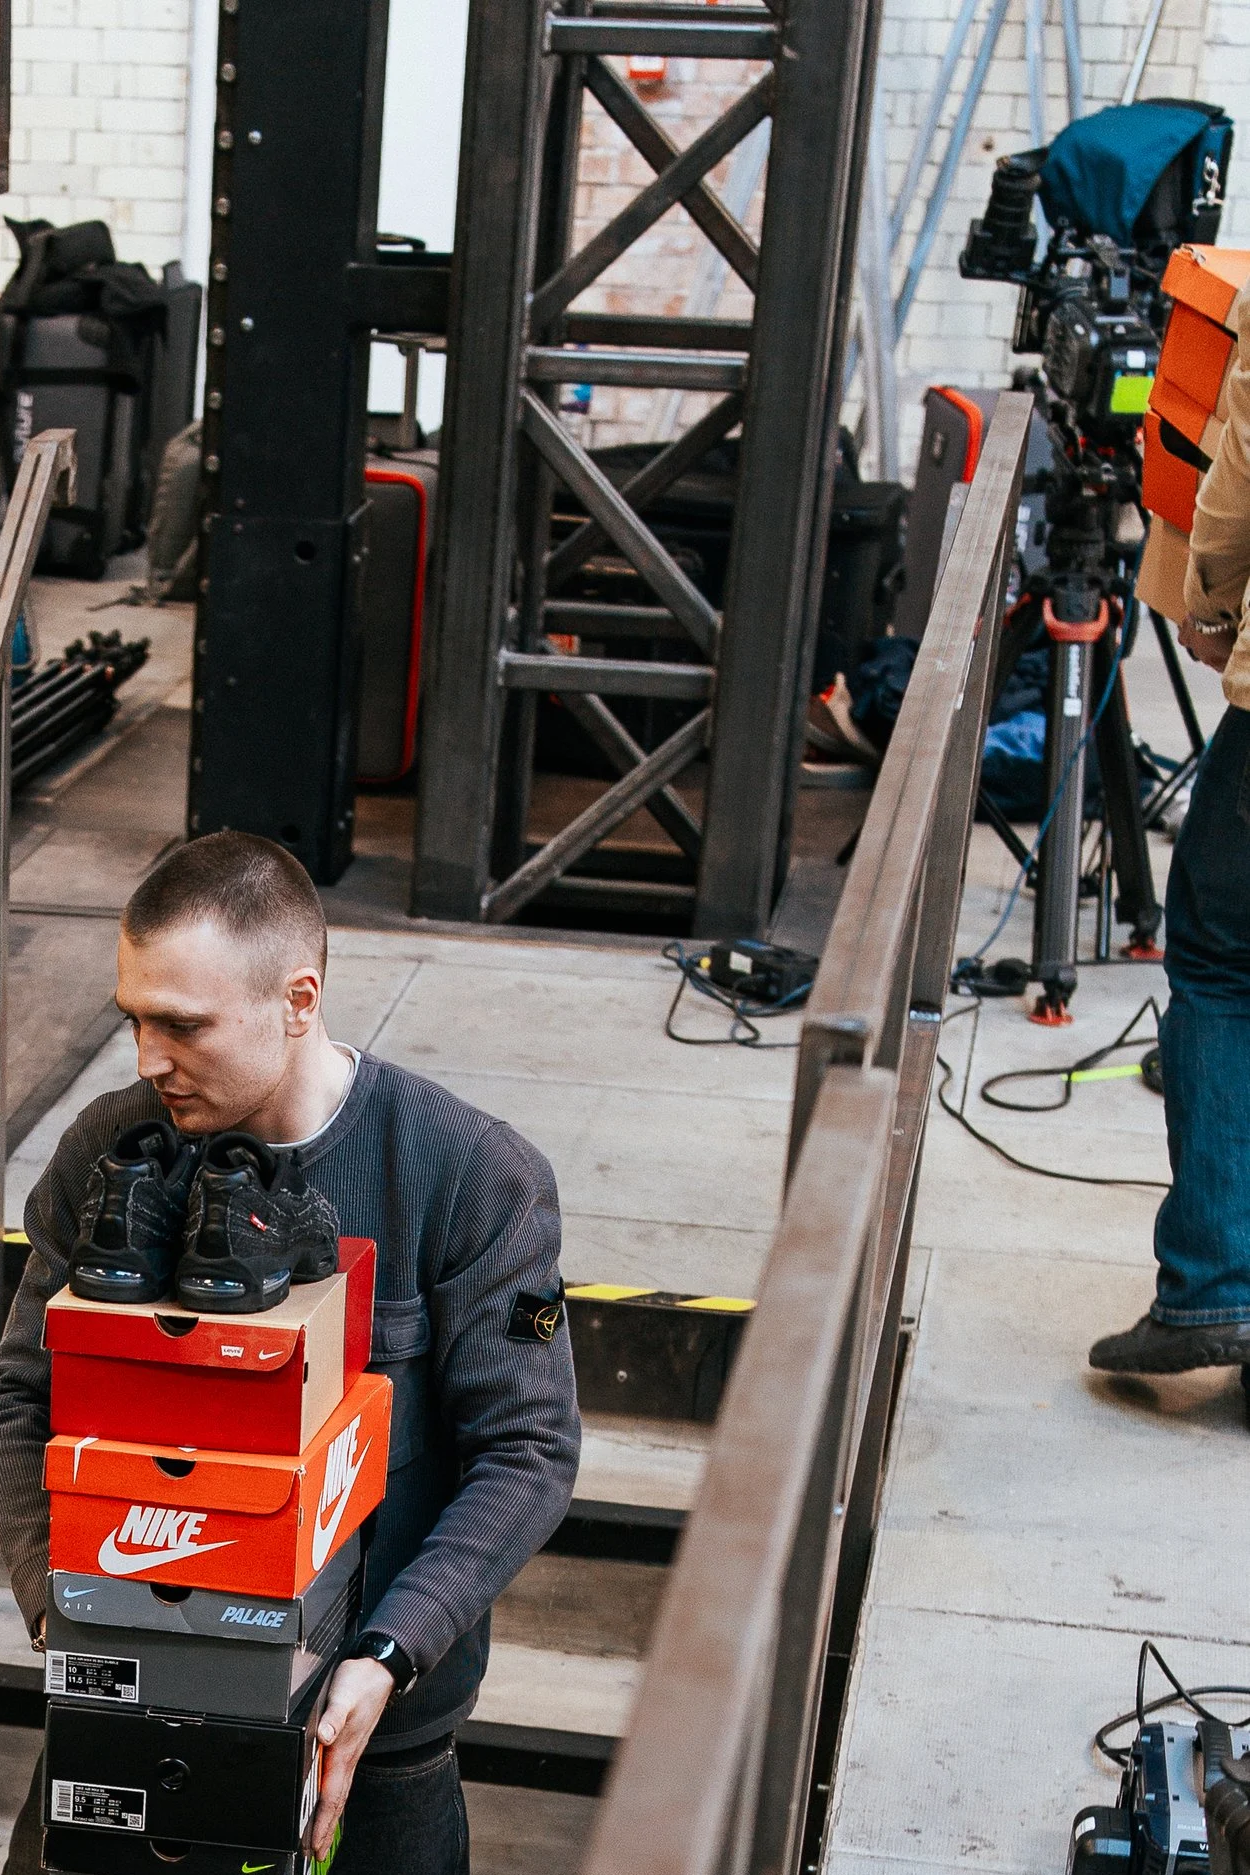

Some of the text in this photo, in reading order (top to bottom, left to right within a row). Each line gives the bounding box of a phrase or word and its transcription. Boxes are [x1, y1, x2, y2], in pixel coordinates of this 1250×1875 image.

[321, 1413, 361, 1513] NIKE
[117, 1505, 207, 1548] NIKE
[64, 1602, 92, 1611] AIR
[220, 1606, 287, 1627] PALACE
[68, 1666, 77, 1674] 10
[68, 1676, 83, 1684] 11.5
[74, 1796, 86, 1804] 9.5
